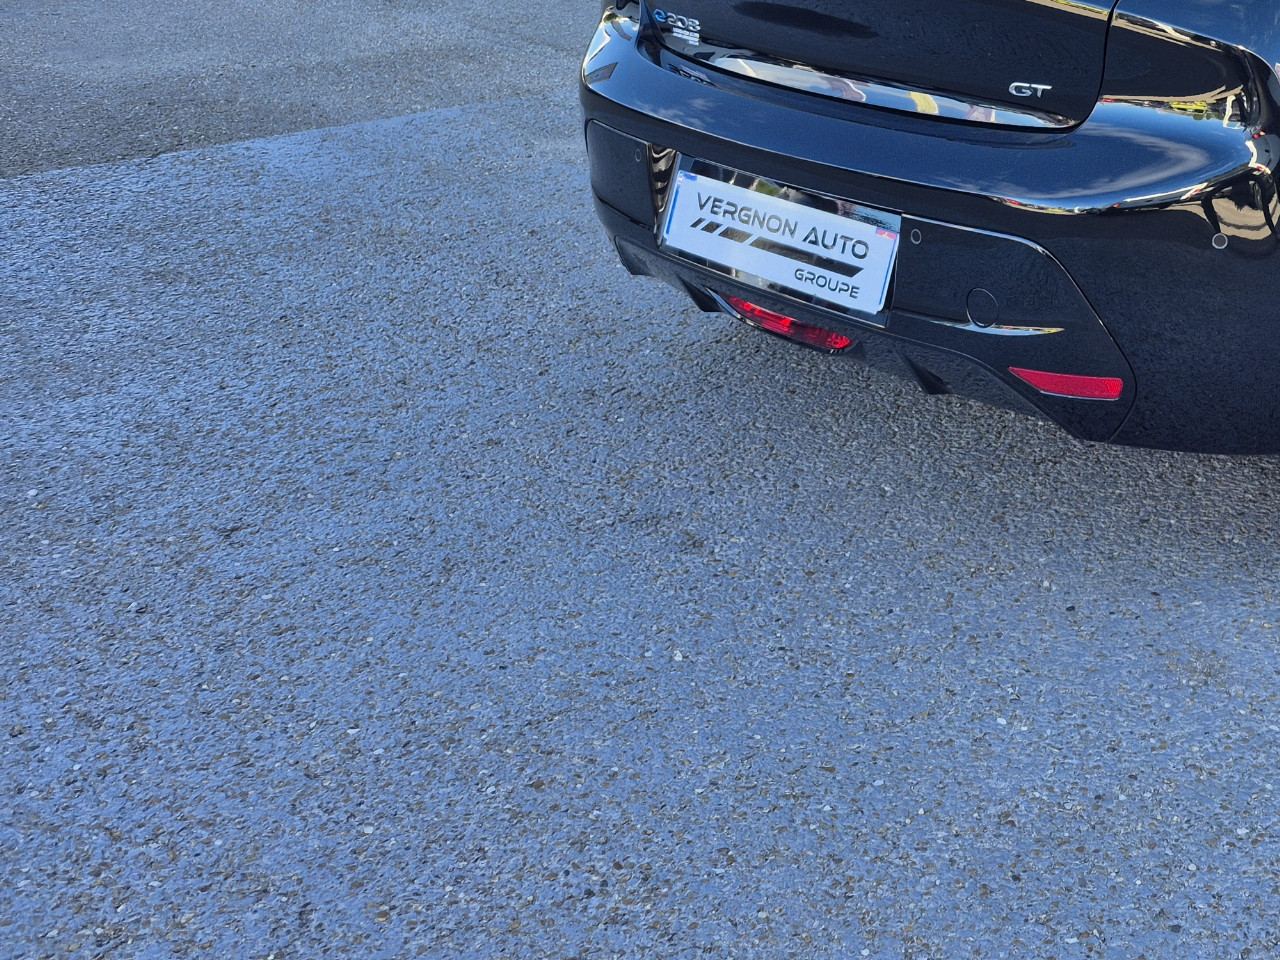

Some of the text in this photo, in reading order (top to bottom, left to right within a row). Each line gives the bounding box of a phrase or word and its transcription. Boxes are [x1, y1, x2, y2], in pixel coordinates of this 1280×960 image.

[1008, 82, 1053, 98] GT
[697, 192, 869, 260] VERGNON AUTO
[794, 268, 861, 299] GROUPE
